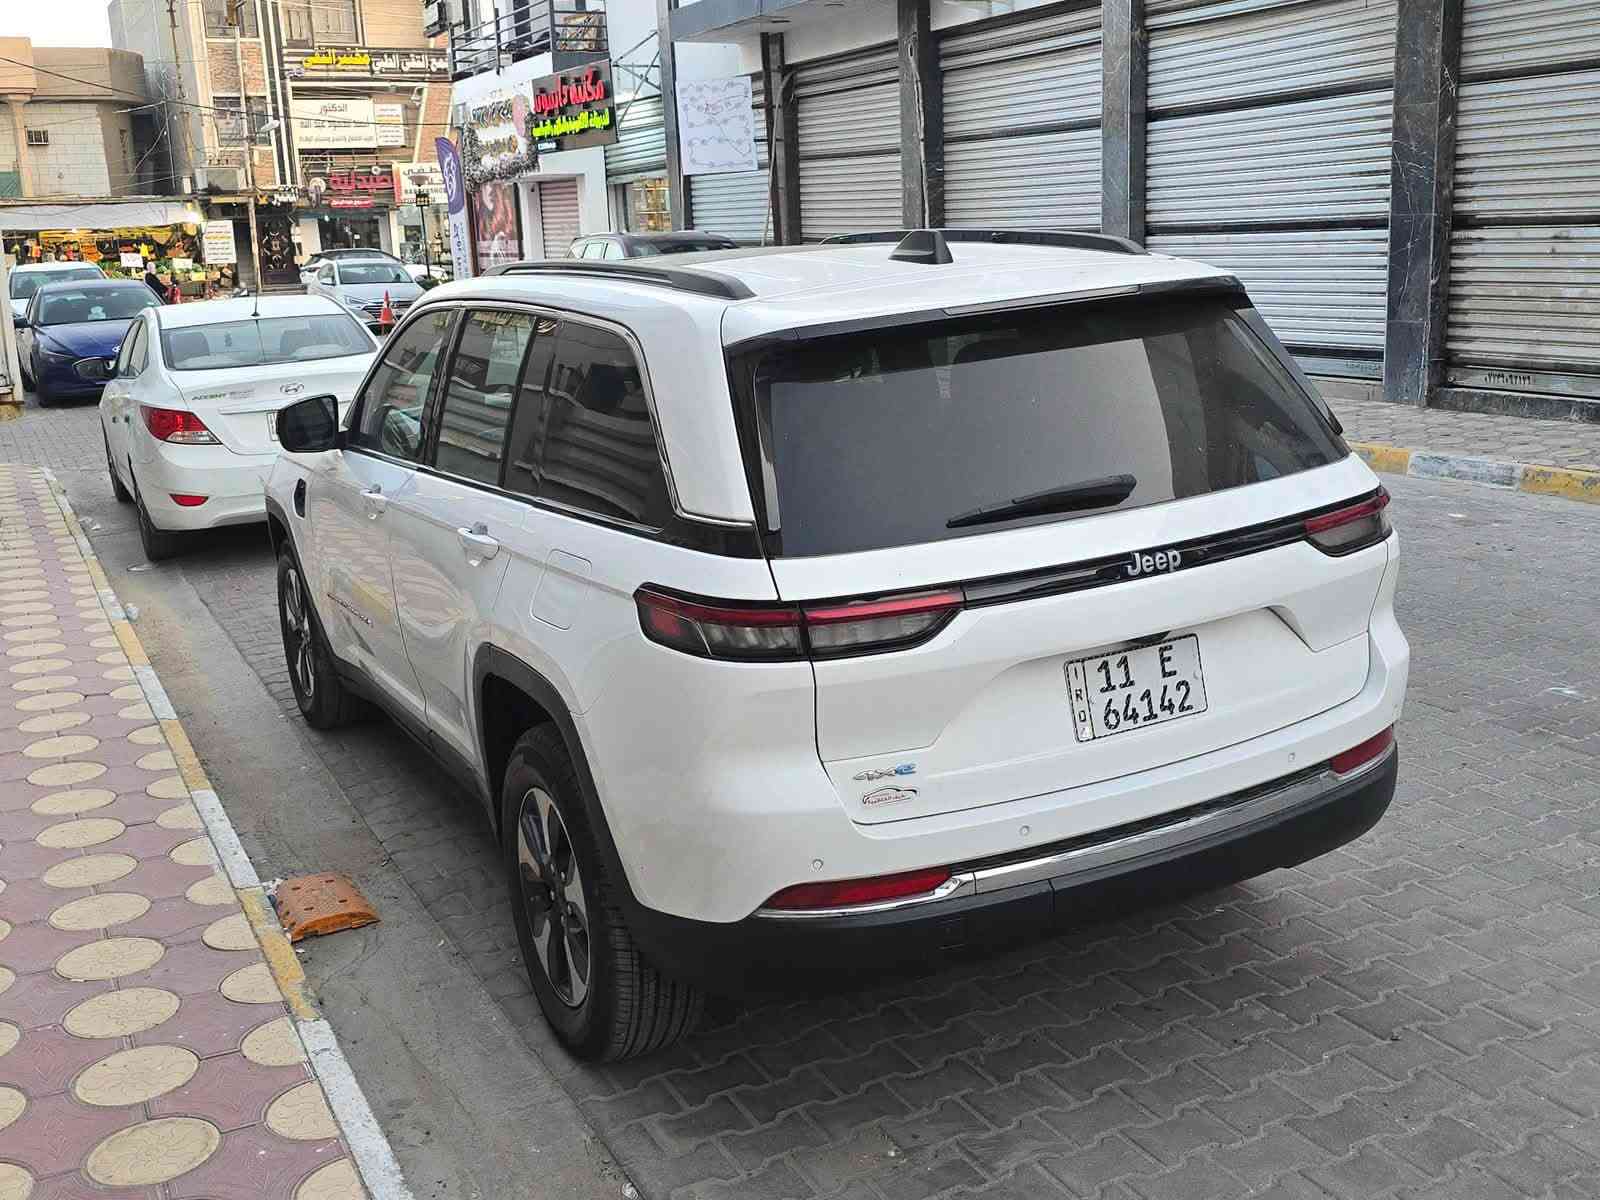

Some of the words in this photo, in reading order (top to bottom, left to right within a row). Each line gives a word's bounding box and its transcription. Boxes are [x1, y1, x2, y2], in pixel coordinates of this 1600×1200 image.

[569, 66, 605, 106] مكتبة
[1127, 550, 1182, 576] Jeep
[1097, 655, 1135, 693] 11
[1158, 645, 1177, 678] E
[1103, 680, 1194, 730] 64142
